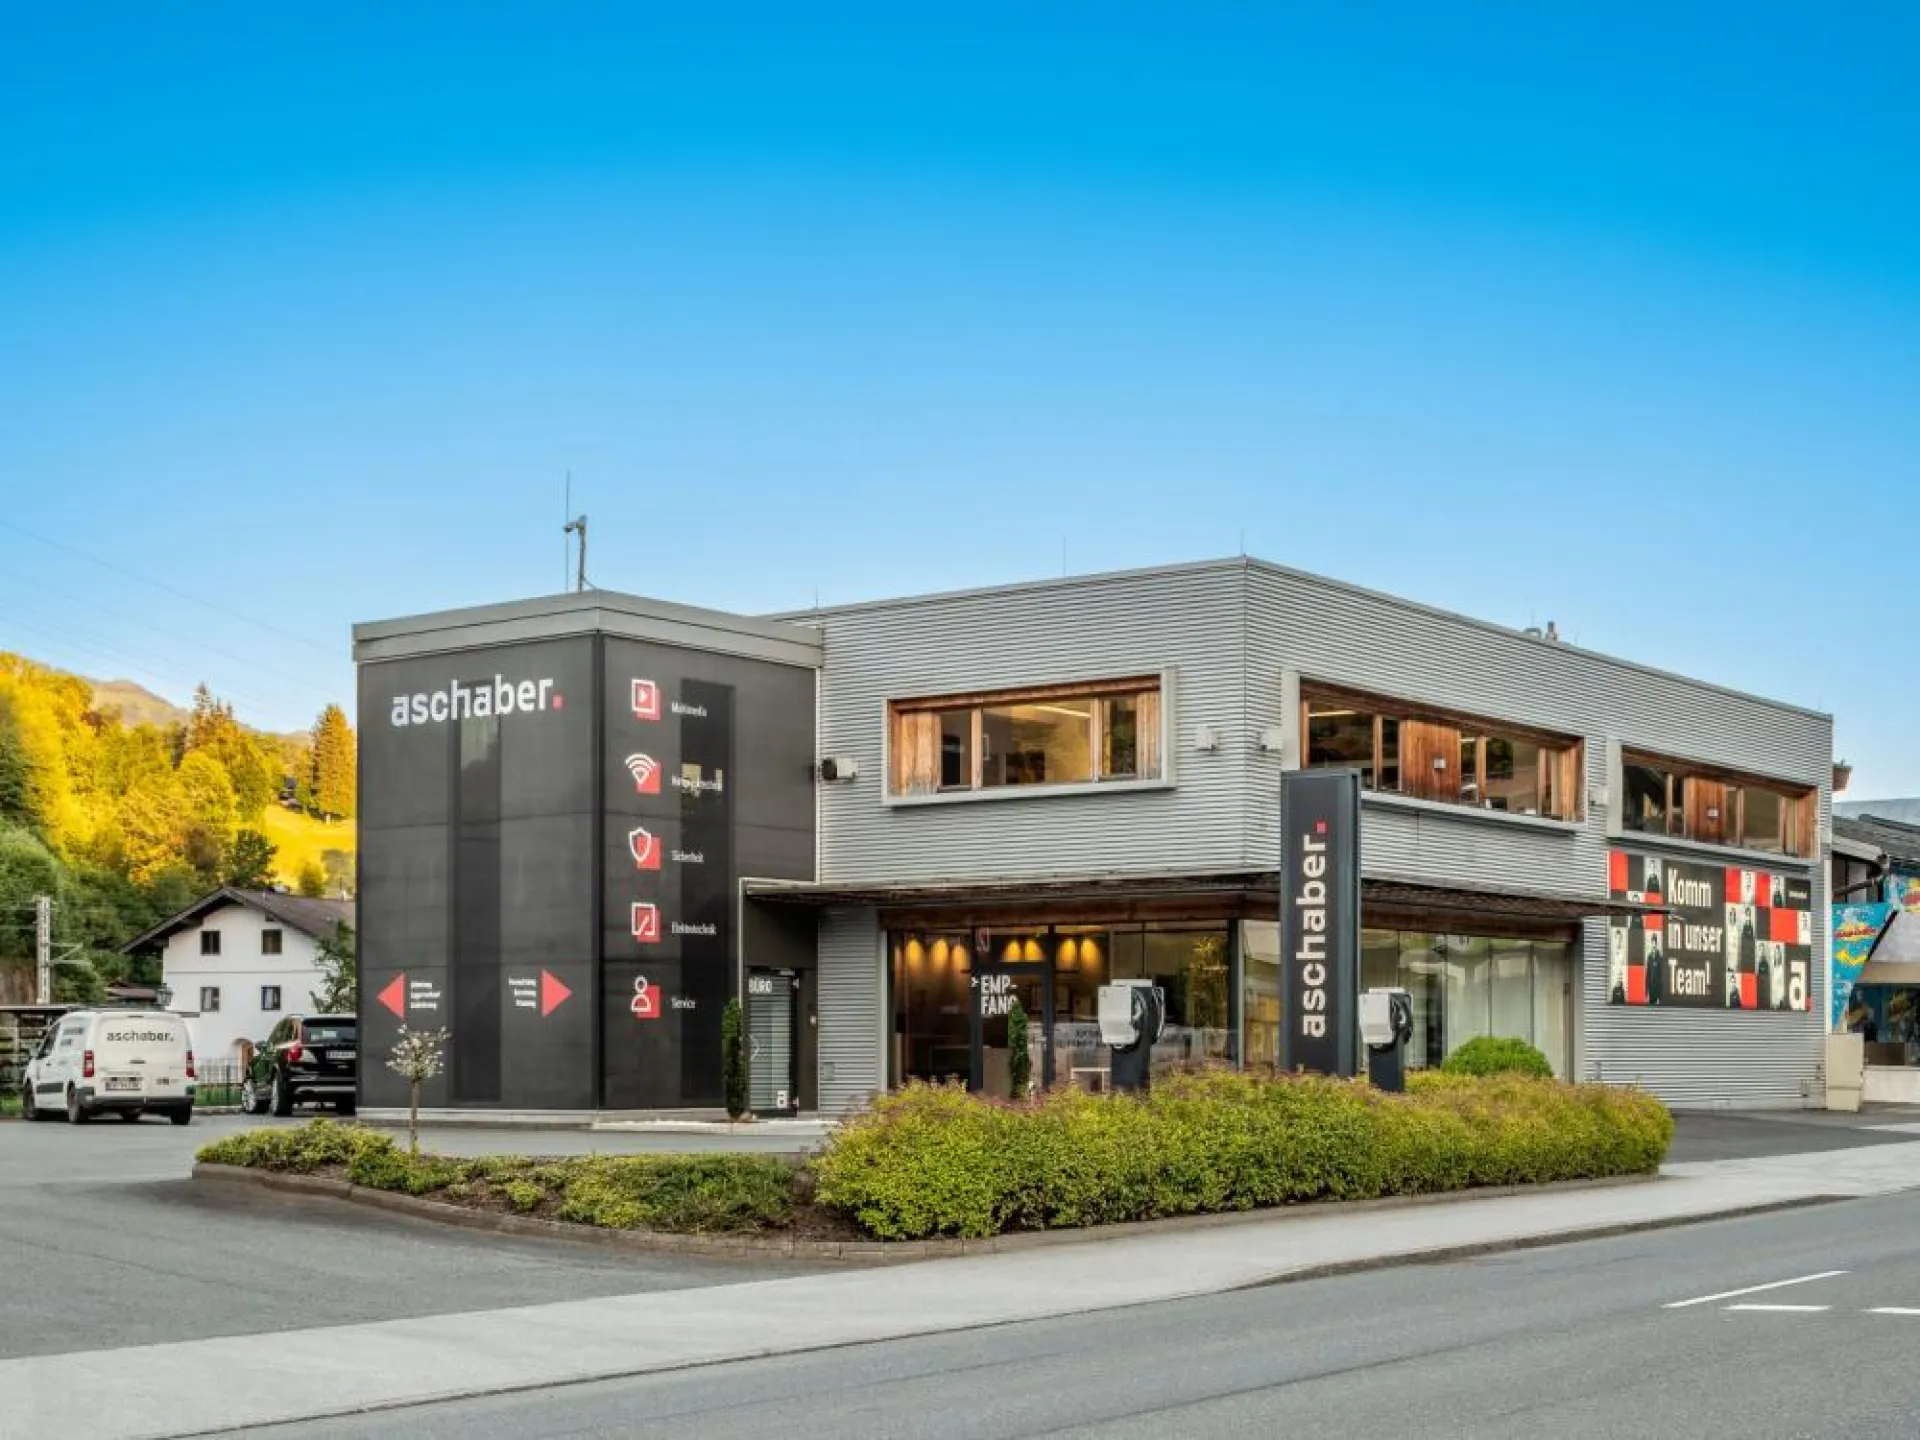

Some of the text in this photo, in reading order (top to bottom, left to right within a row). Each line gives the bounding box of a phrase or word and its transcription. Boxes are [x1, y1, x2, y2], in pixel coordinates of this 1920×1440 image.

[391, 673, 564, 727] aschaber.
[1667, 867, 1712, 908] Komm
[1296, 819, 1327, 1038] aschaber.
[1667, 913, 1723, 953] in unser
[748, 976, 773, 994] BÜRO
[980, 974, 1019, 994] EMP-
[1667, 957, 1712, 995] Team!
[106, 1030, 174, 1043] aschaber.
